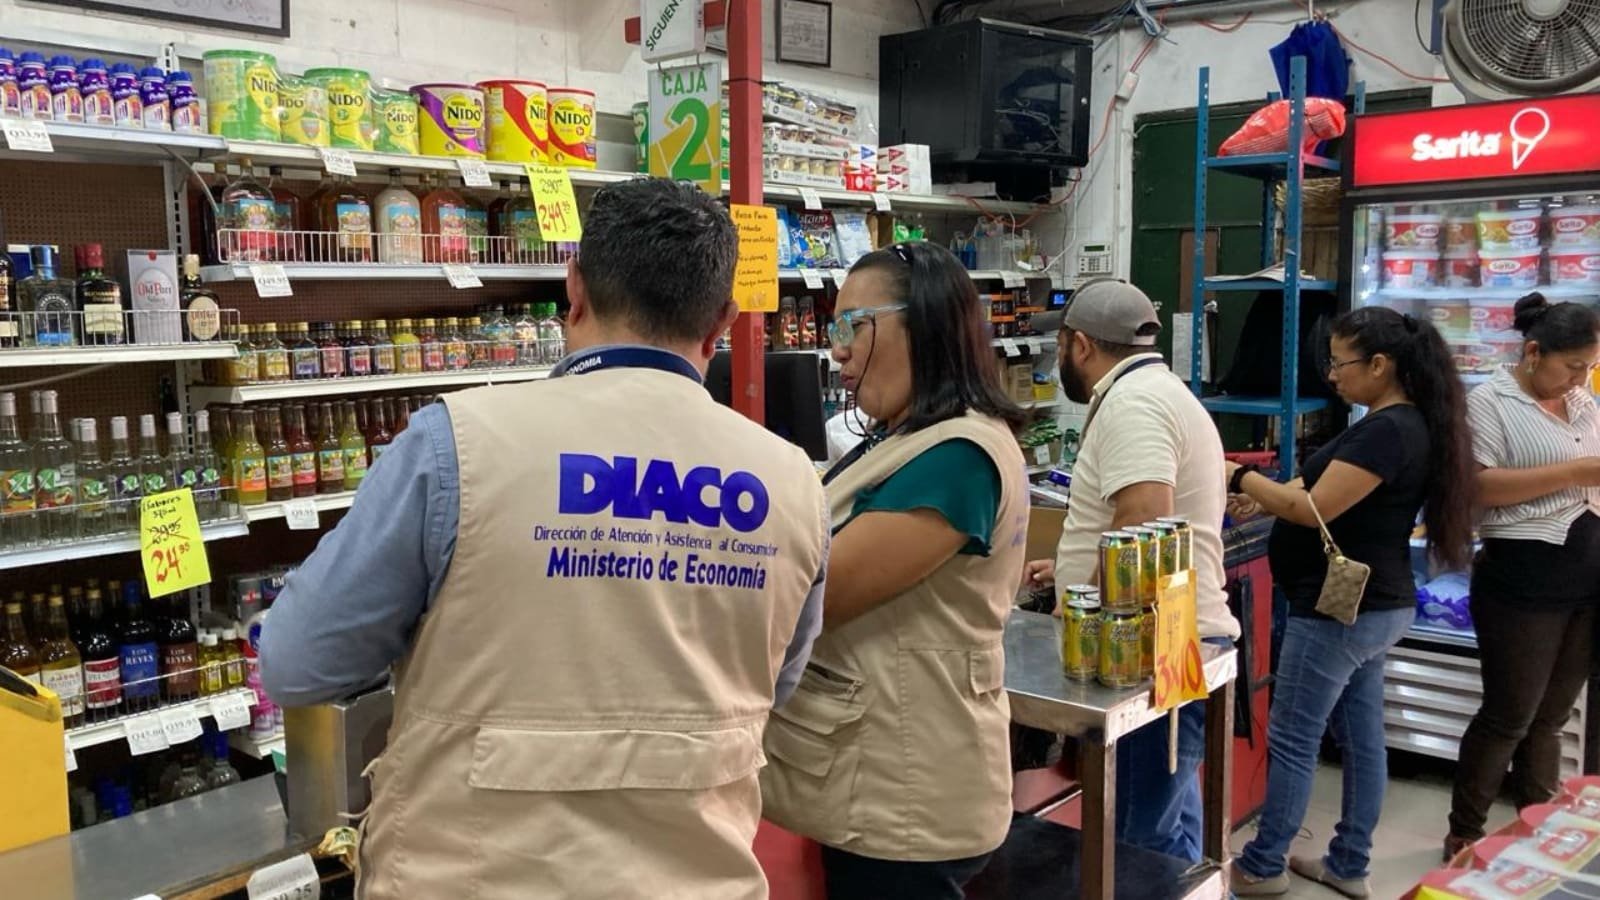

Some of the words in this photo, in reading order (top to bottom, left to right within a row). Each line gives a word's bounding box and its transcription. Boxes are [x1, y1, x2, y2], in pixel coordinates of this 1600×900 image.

[645, 0, 681, 51] SIGUIEN
[251, 77, 278, 93] NID
[662, 72, 708, 96] CAJA
[328, 92, 363, 107] NIDO
[387, 112, 415, 124] NIDO
[447, 105, 481, 122] NIDO
[530, 105, 547, 120] NID
[554, 110, 590, 126] NIDO
[671, 98, 712, 181] 2
[1411, 130, 1502, 162] Sarita
[559, 453, 770, 533] DIACO
[534, 525, 587, 541] Dirección
[590, 527, 605, 541] de
[609, 527, 653, 544] Atención
[655, 534, 661, 546] y
[664, 531, 712, 550] Asistencia
[719, 538, 729, 551] al
[546, 546, 654, 580] Ministerio
[658, 551, 679, 582] de
[685, 553, 766, 590] Economía
[125, 655, 154, 665] REYES
